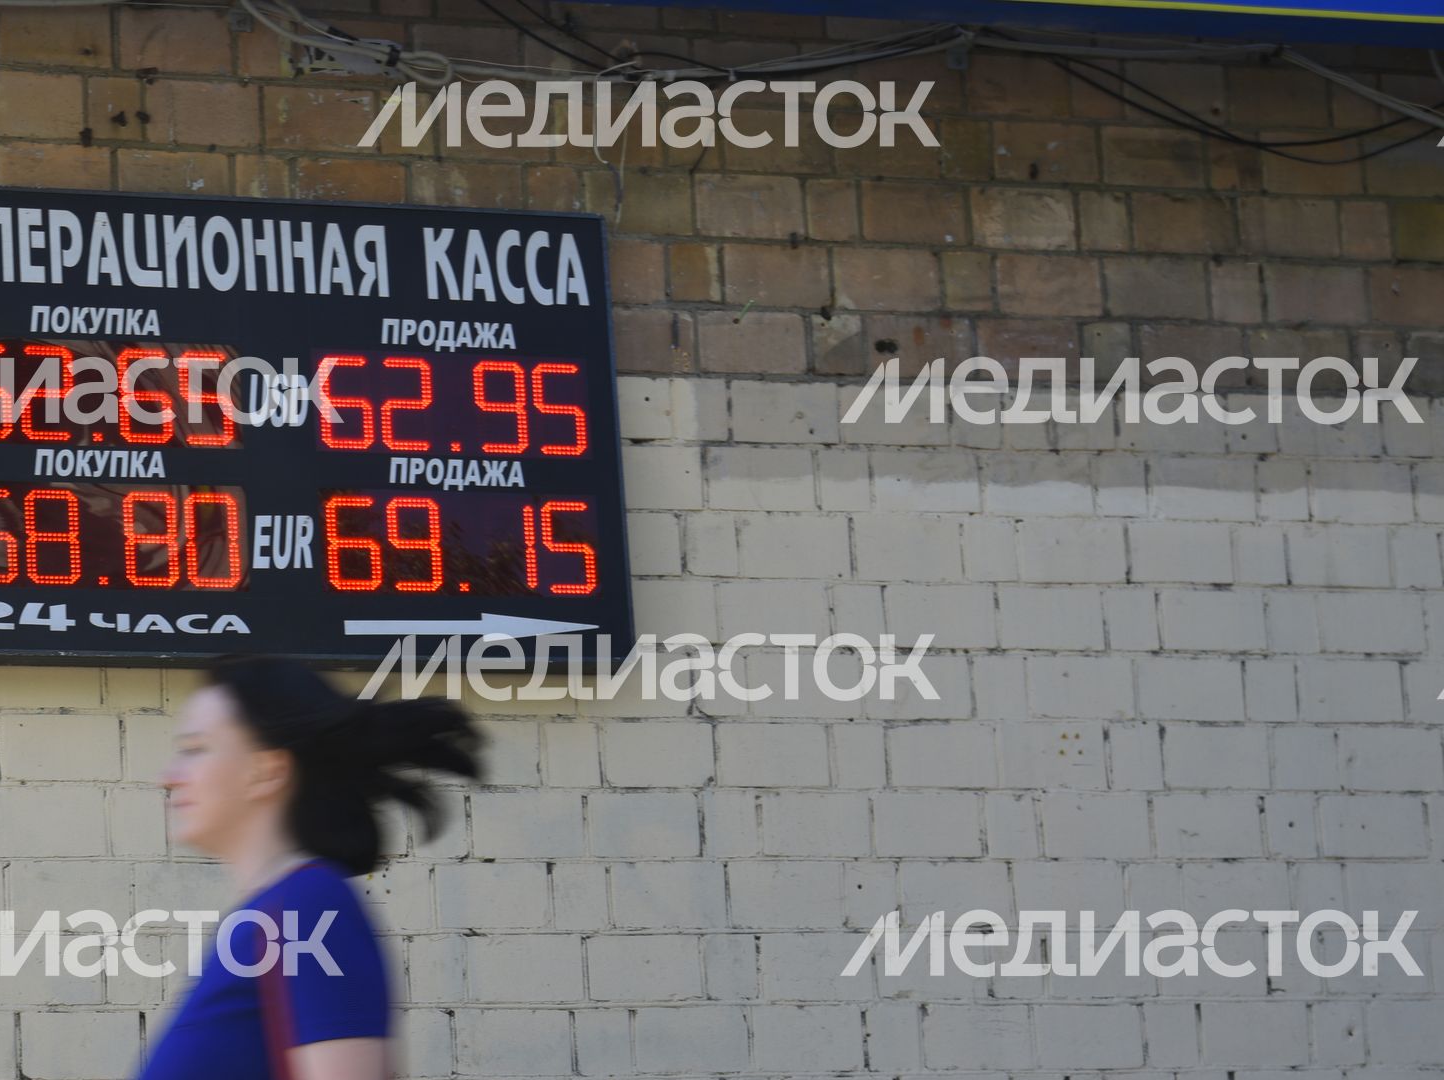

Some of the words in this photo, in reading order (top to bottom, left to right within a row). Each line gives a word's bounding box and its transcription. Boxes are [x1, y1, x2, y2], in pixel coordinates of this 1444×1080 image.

[424, 227, 590, 306] КАССА
[30, 305, 161, 336] ПОКУПКА
[381, 318, 517, 351] ПРОДАЖА
[249, 374, 309, 428] USD
[316, 356, 589, 457] 62.95
[34, 449, 166, 479] ПОКУПКА
[389, 457, 525, 489] ПРОДАЖА
[254, 515, 314, 570] EUR
[324, 496, 598, 595] 69.15
